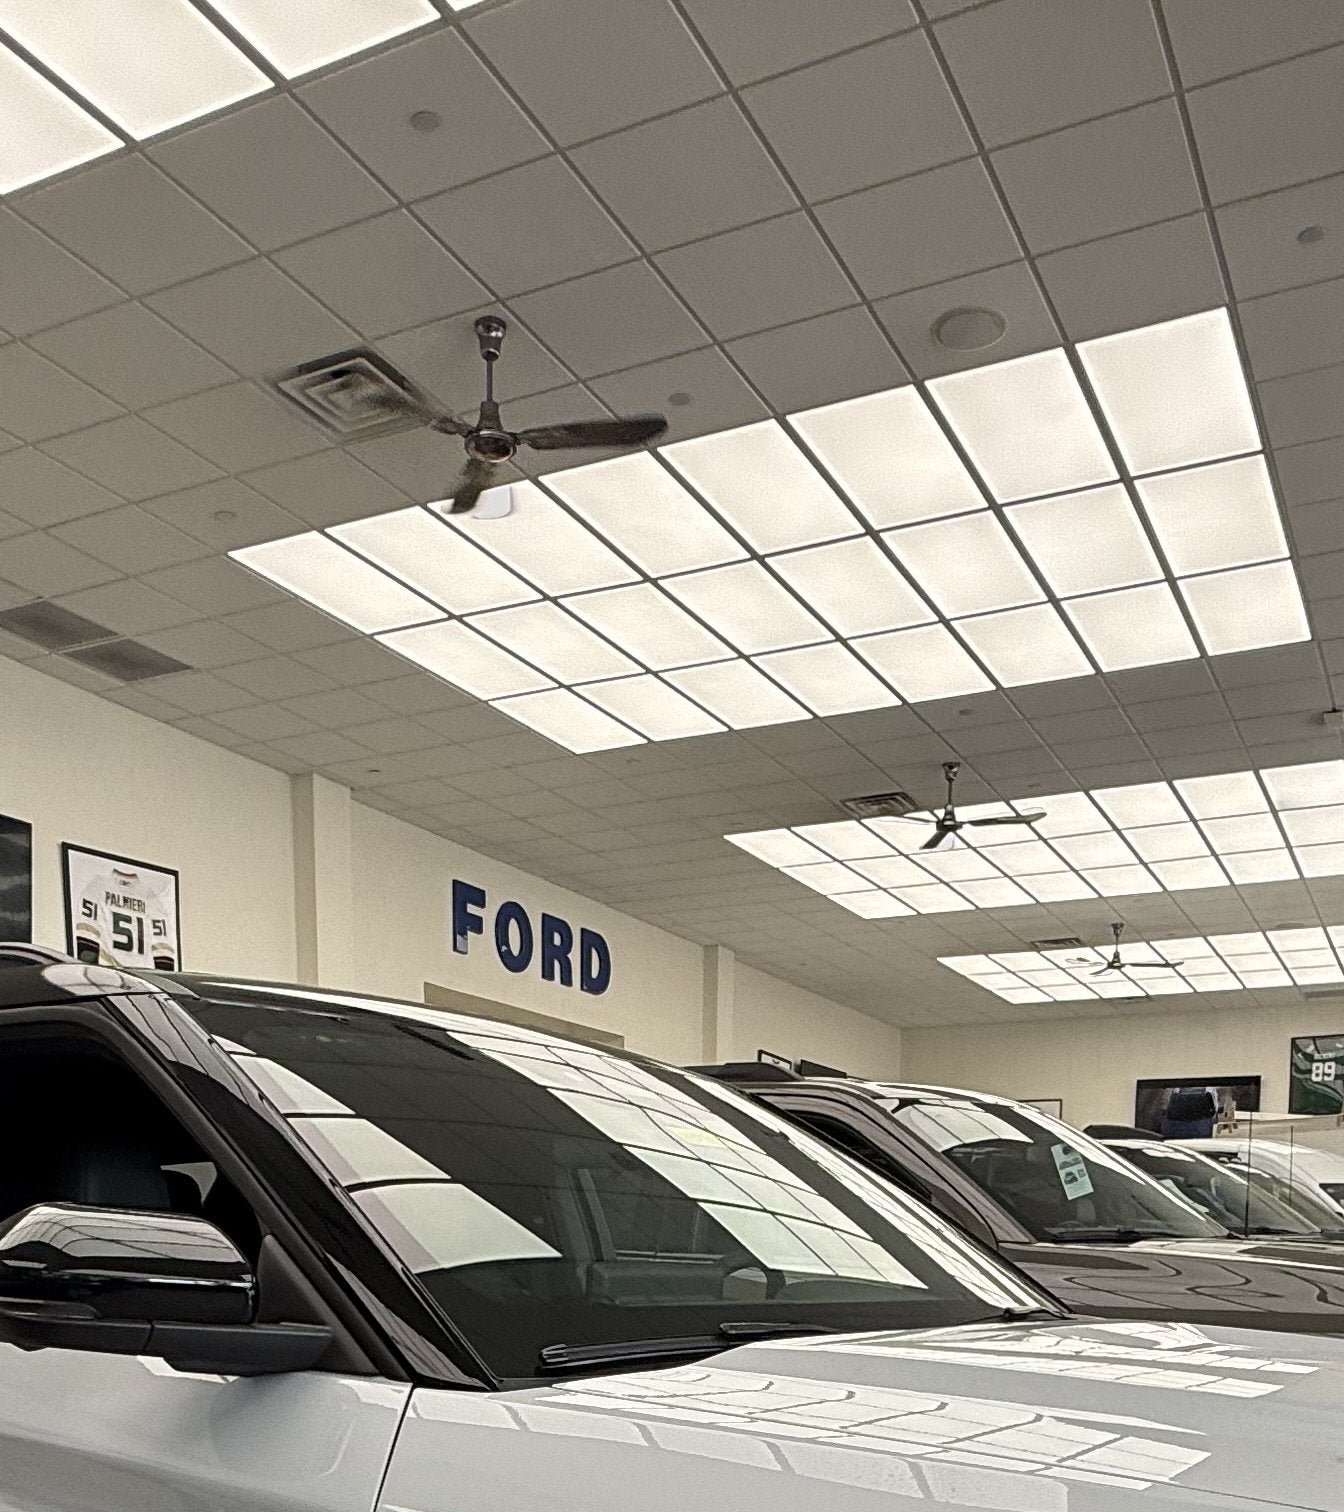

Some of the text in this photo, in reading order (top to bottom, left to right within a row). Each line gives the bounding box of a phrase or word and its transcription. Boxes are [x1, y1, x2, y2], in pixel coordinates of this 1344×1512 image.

[81, 898, 98, 921] 51
[112, 911, 145, 956] 51
[151, 919, 167, 937] 51
[452, 879, 612, 996] FORD
[1311, 1061, 1336, 1082] 89
